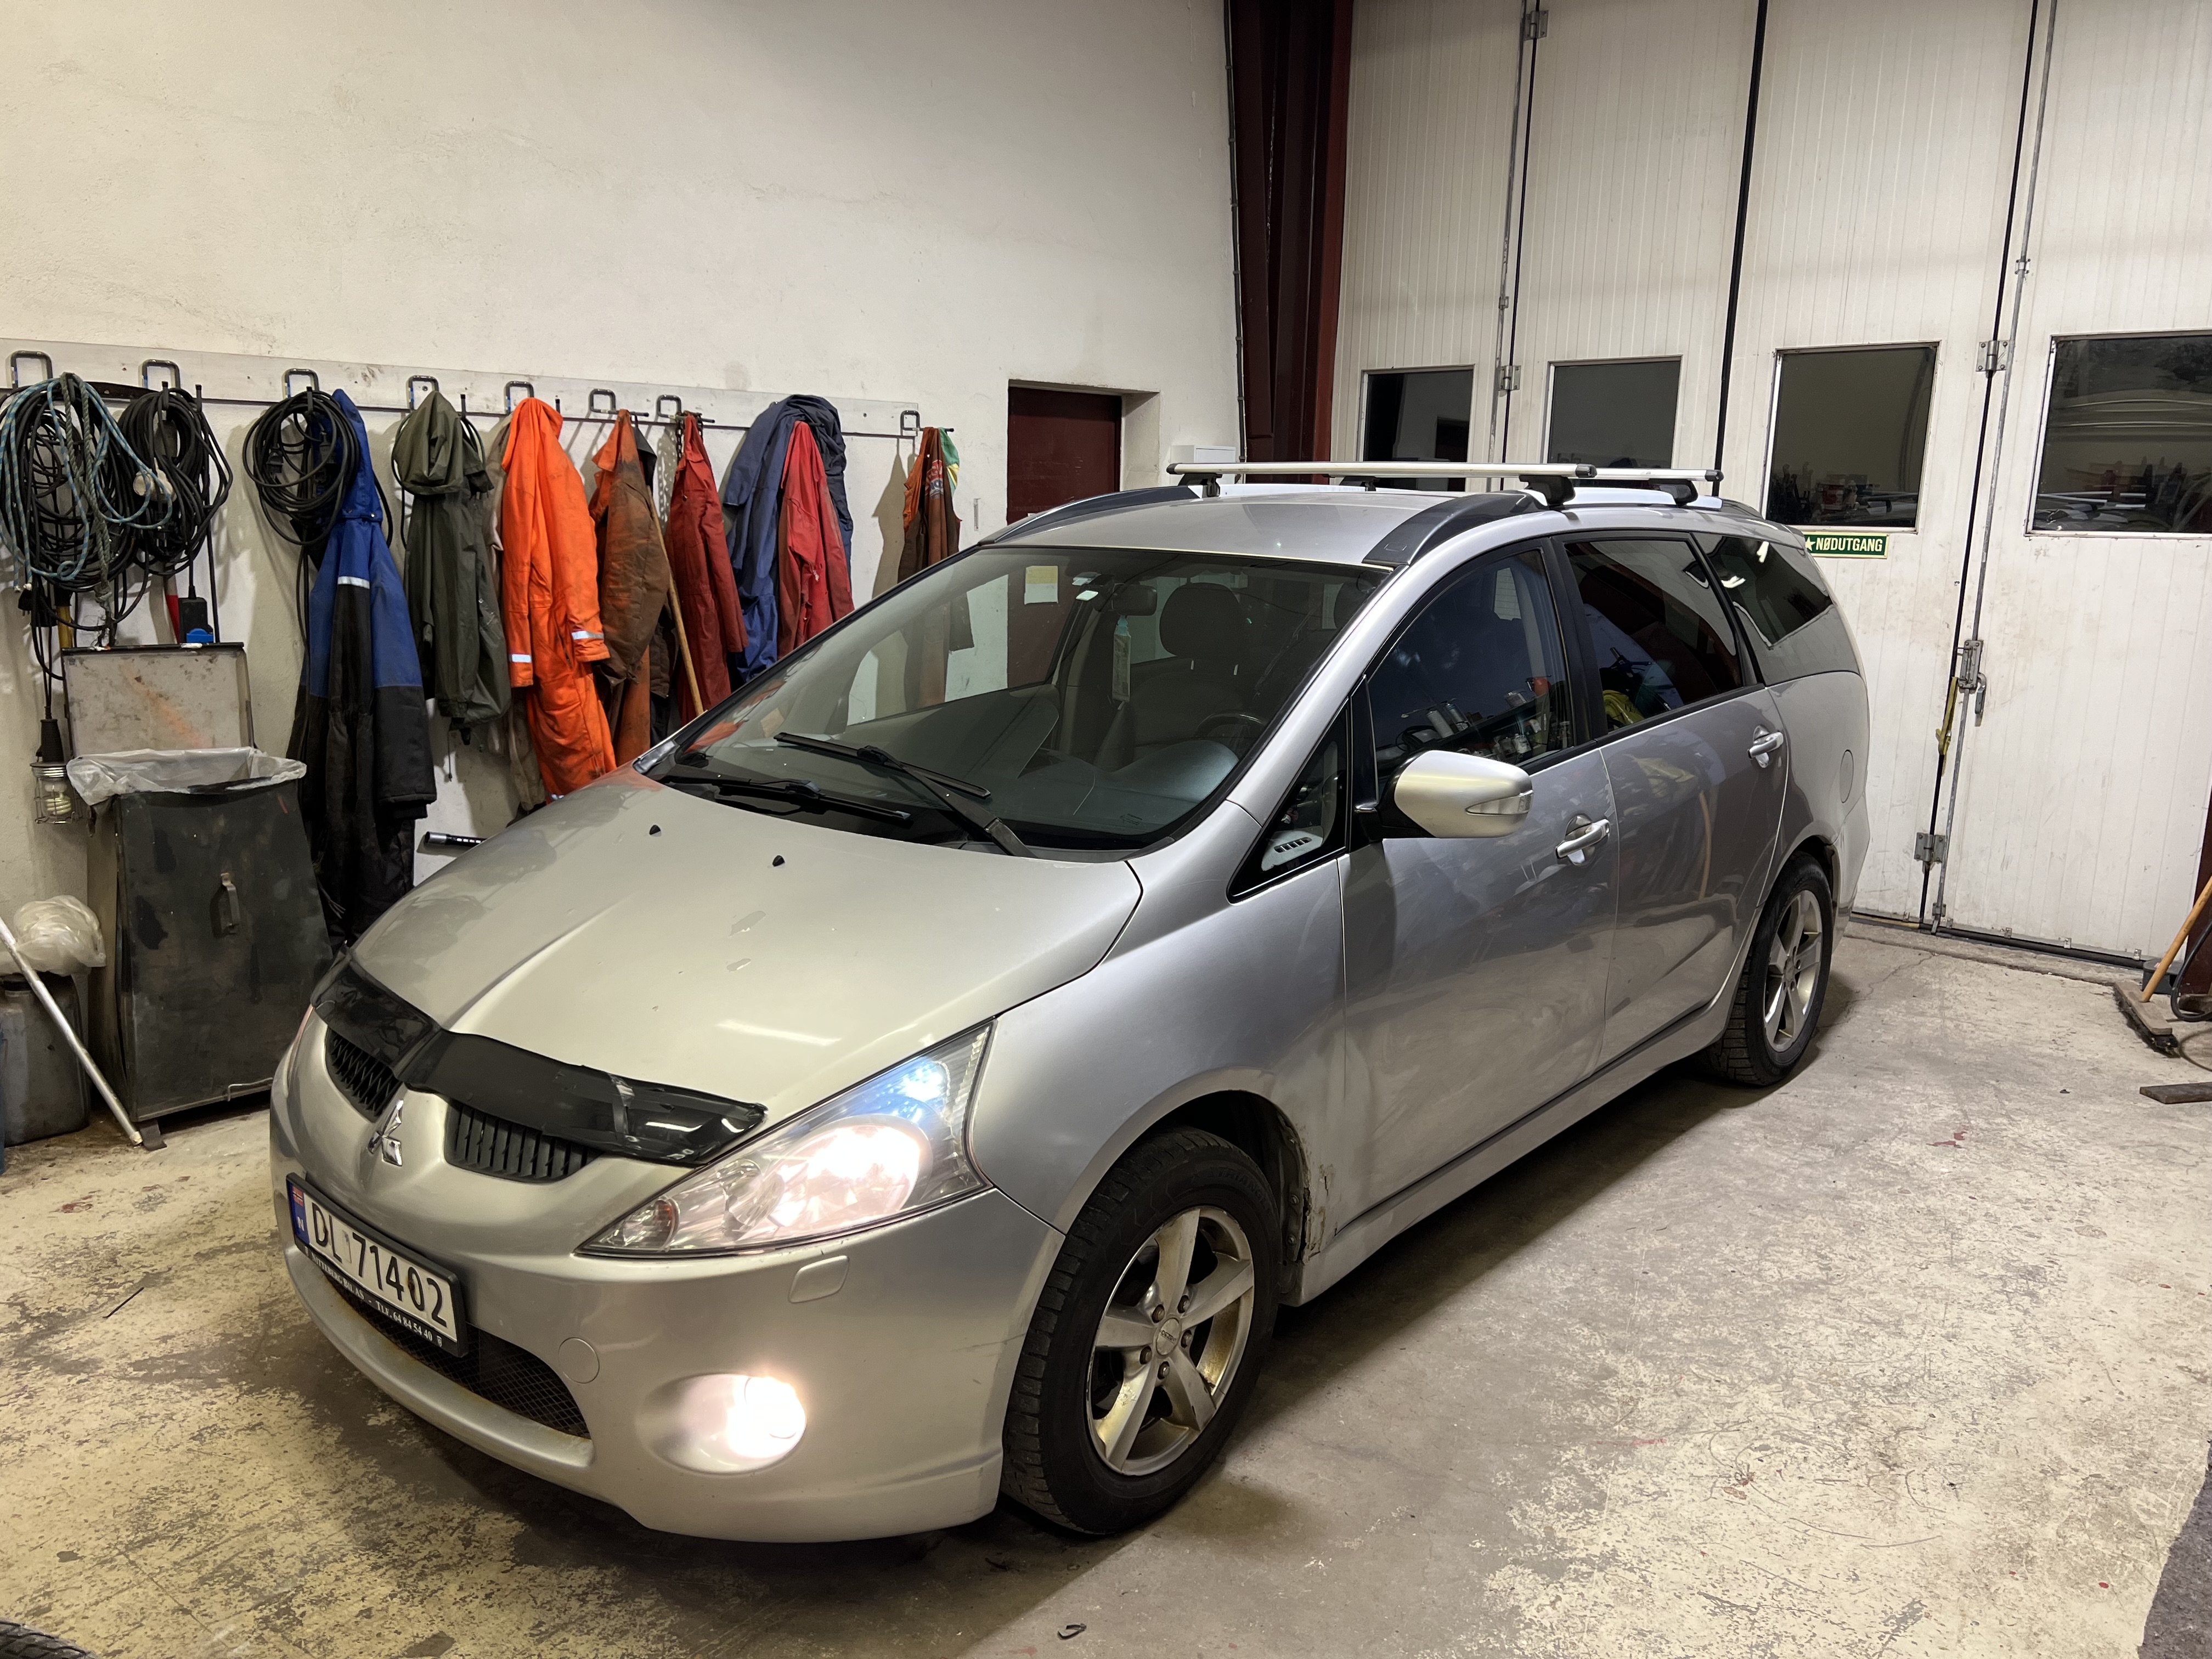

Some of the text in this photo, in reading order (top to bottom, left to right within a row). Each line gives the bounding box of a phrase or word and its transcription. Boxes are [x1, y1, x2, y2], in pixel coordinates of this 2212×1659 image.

[1816, 537, 1883, 552] NØDUTGANG
[297, 1216, 304, 1232] N
[312, 1202, 447, 1328] DL 71402
[355, 1288, 364, 1300] AS
[393, 1312, 402, 1324] 64
[403, 1317, 412, 1329] 84
[413, 1323, 422, 1336] 54
[424, 1329, 433, 1341] 40
